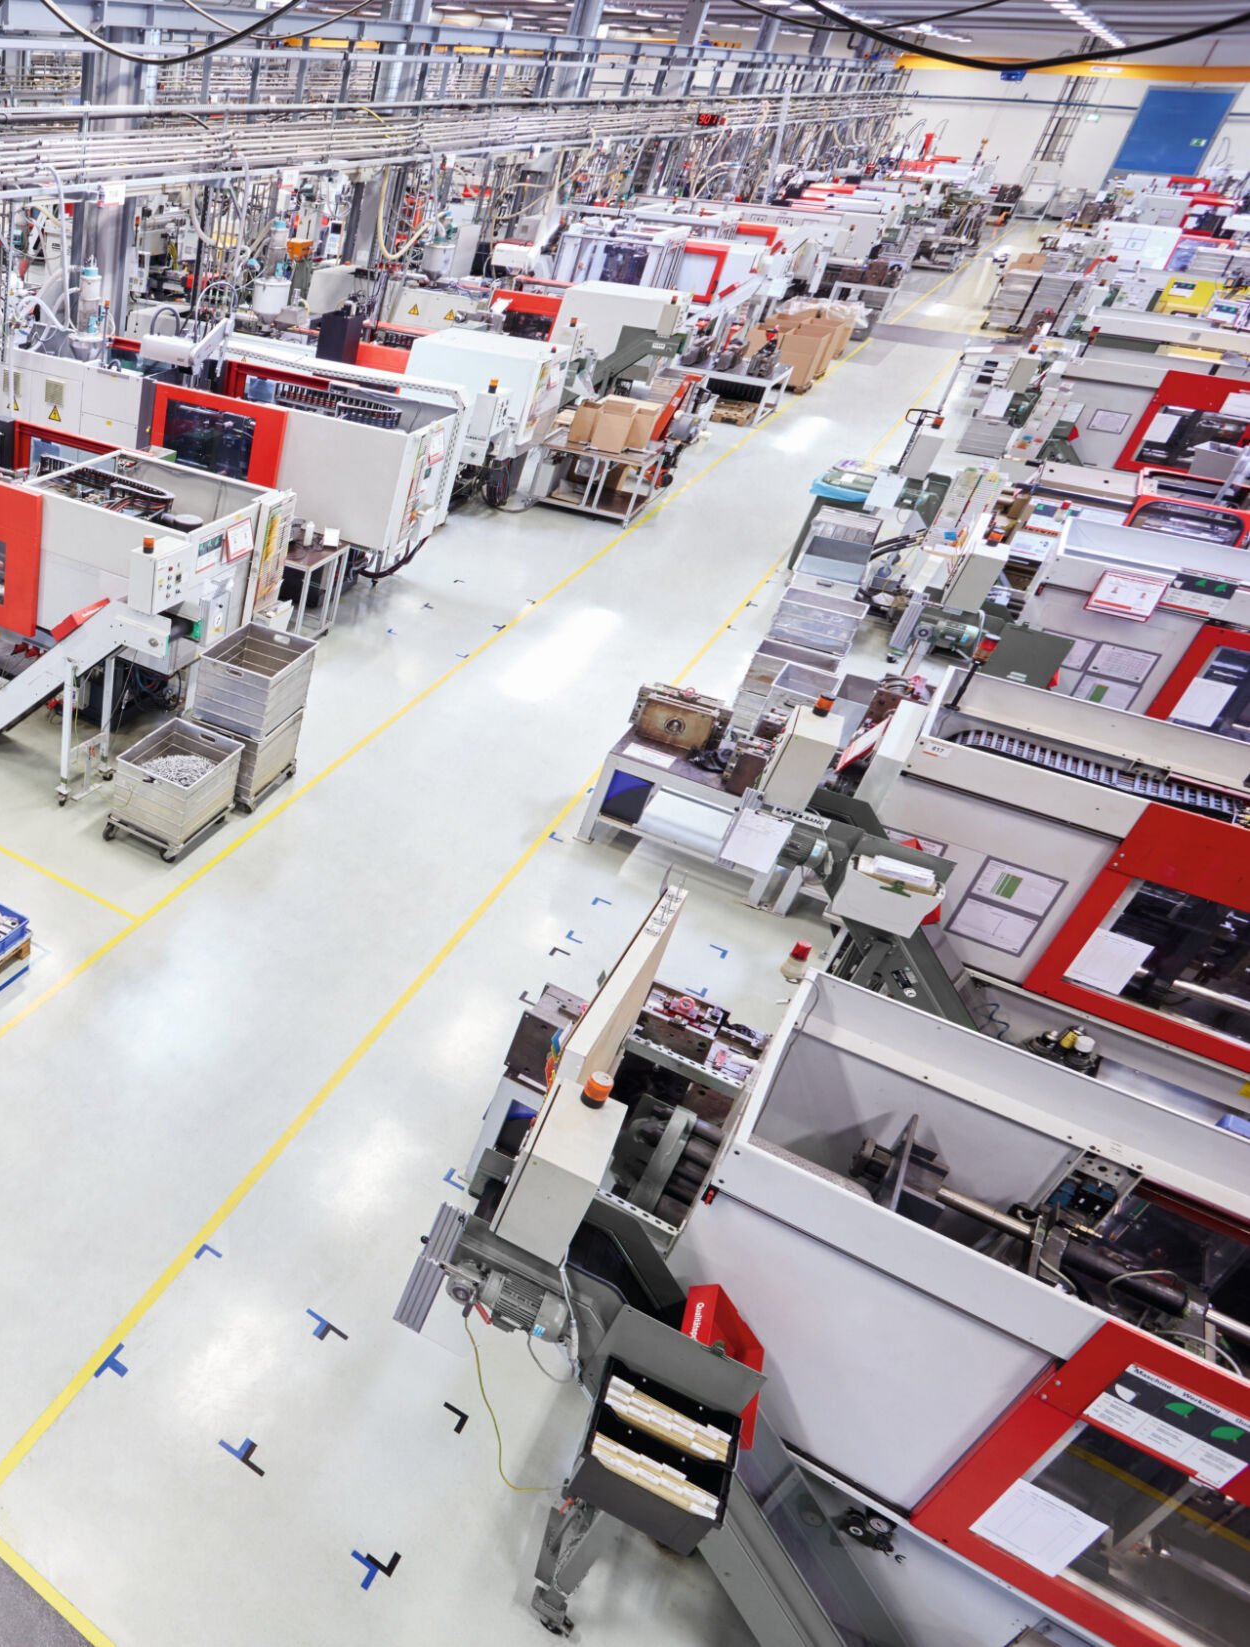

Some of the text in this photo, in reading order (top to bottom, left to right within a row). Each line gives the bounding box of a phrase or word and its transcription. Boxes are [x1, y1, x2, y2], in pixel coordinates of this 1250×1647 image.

[698, 113, 718, 125] 901
[1134, 1367, 1172, 1391] Maschine
[1182, 1391, 1222, 1415] Werkzeug
